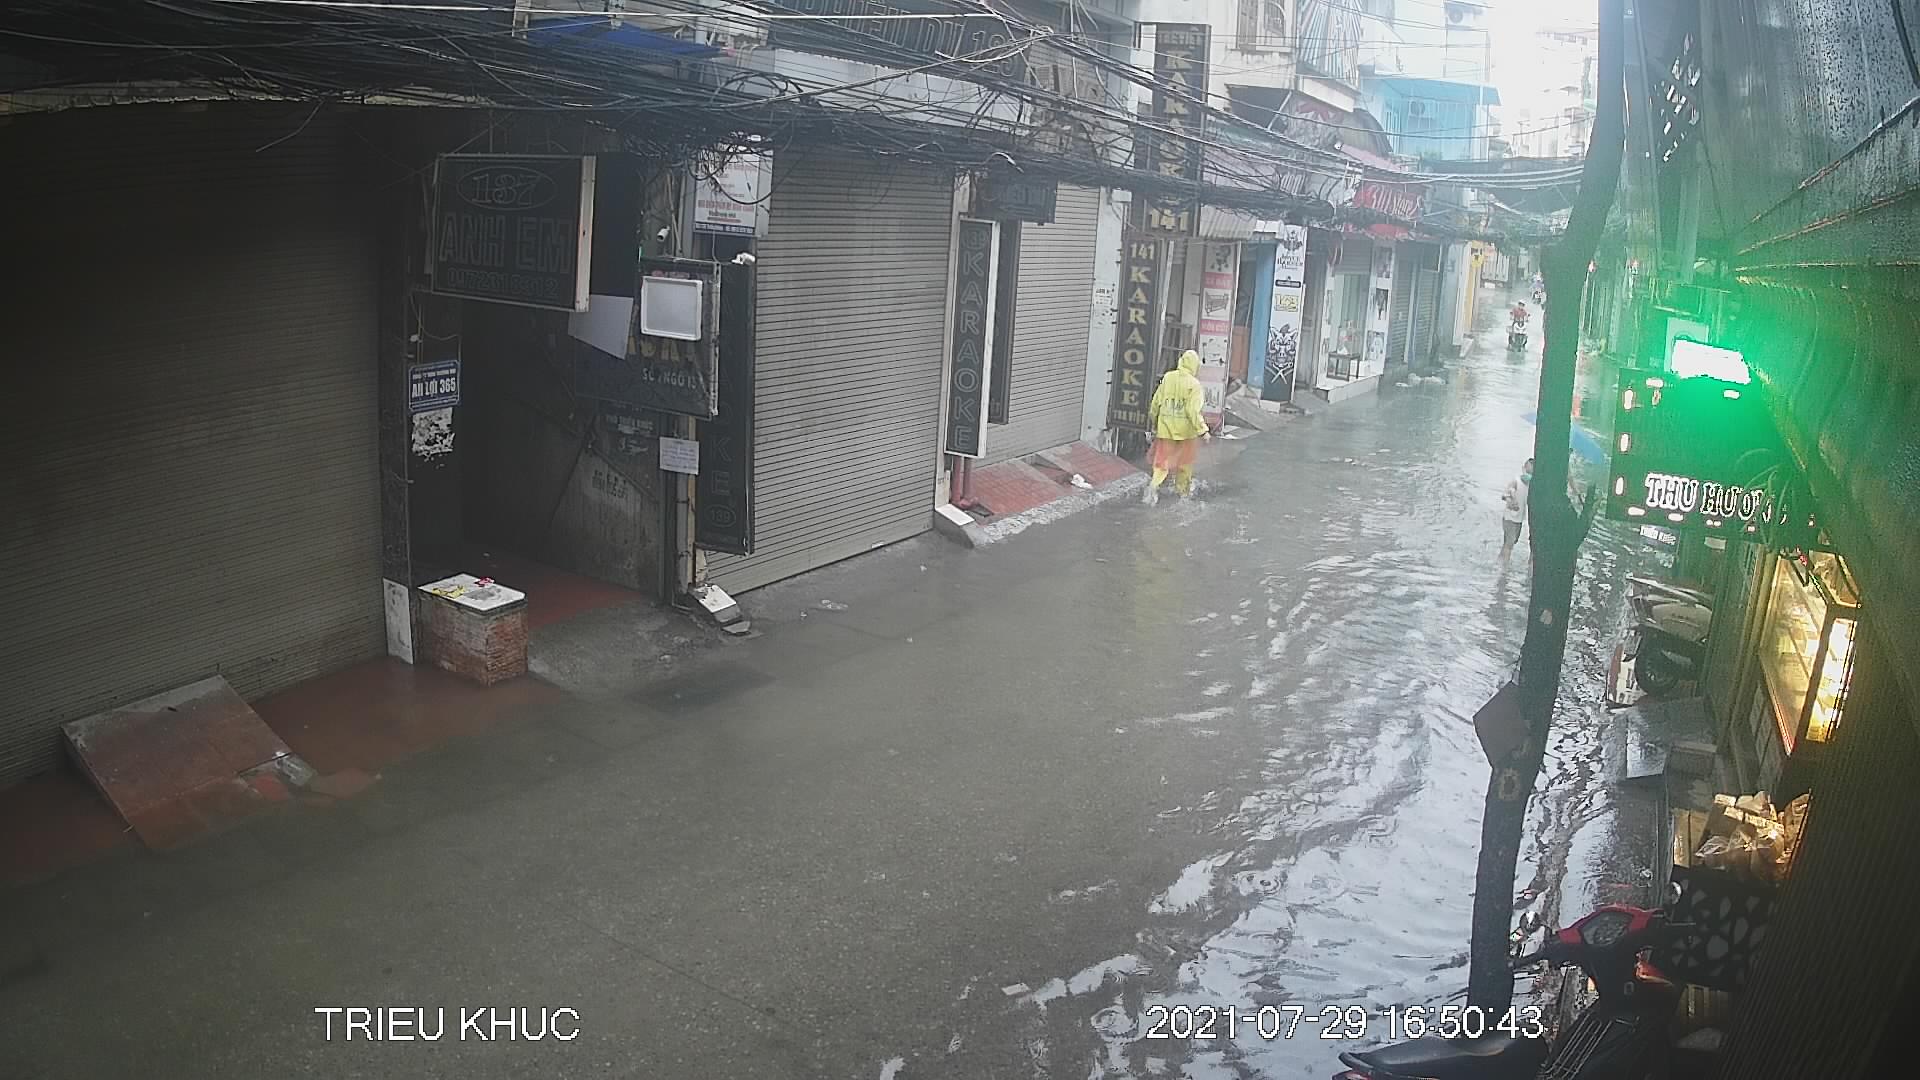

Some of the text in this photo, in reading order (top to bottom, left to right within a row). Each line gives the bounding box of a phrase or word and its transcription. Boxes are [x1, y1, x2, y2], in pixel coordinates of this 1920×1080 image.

[471, 173, 542, 206] 137
[1150, 207, 1189, 232] 141
[439, 211, 574, 275] ANH EM
[1129, 243, 1154, 260] 141
[952, 251, 985, 450] KARAOKE
[1119, 266, 1151, 407] KARAOKE
[439, 377, 456, 393] 365
[1645, 473, 1699, 512] THU
